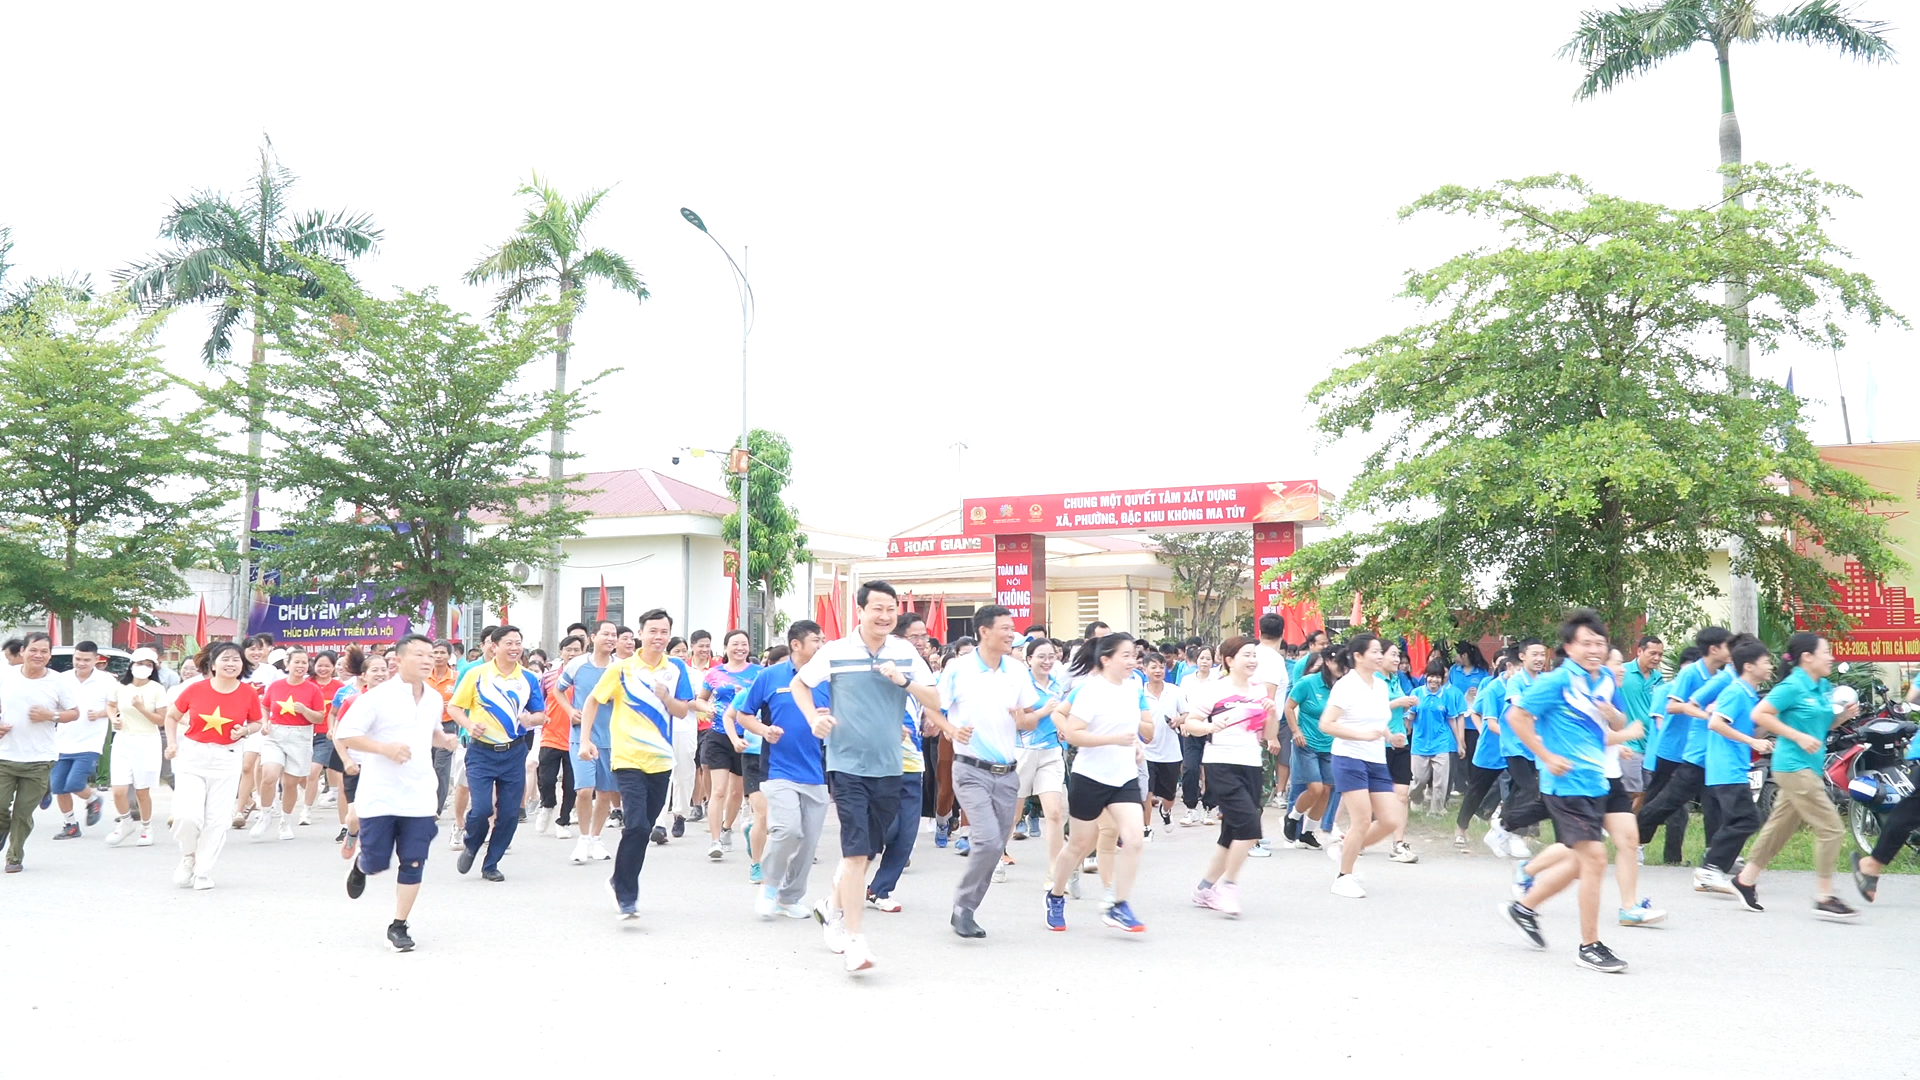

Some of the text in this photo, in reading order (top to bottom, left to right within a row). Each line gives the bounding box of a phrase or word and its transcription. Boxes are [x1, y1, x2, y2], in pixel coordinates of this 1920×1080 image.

[1063, 488, 1237, 509] CHUNG MỘT QUYẾT TÂM XÂY DỰNG
[1074, 511, 1118, 526] PHƯỜNG,
[1121, 509, 1142, 526] ĐẶC
[1144, 511, 1165, 523] KHU
[1167, 507, 1203, 522] KHÔNG
[1206, 508, 1224, 520] MA
[1226, 504, 1246, 519] TÚY
[940, 537, 982, 551] GIANG
[997, 562, 1029, 576] TOÀN DÂN
[1006, 577, 1021, 586] NÓI
[998, 588, 1031, 606] KHÔNG
[1019, 606, 1030, 618] TÚY
[282, 626, 302, 638] THÚC
[303, 624, 319, 638] ĐẨY
[320, 626, 341, 637] PHÁT
[343, 623, 366, 636] TRIỂN
[380, 625, 394, 638] HỘI
[1834, 640, 1871, 657] 15-3-2026,
[1882, 640, 1893, 656] TRI
[1894, 636, 1905, 655] CẢ
[1905, 638, 1920, 656] NƯỚ
